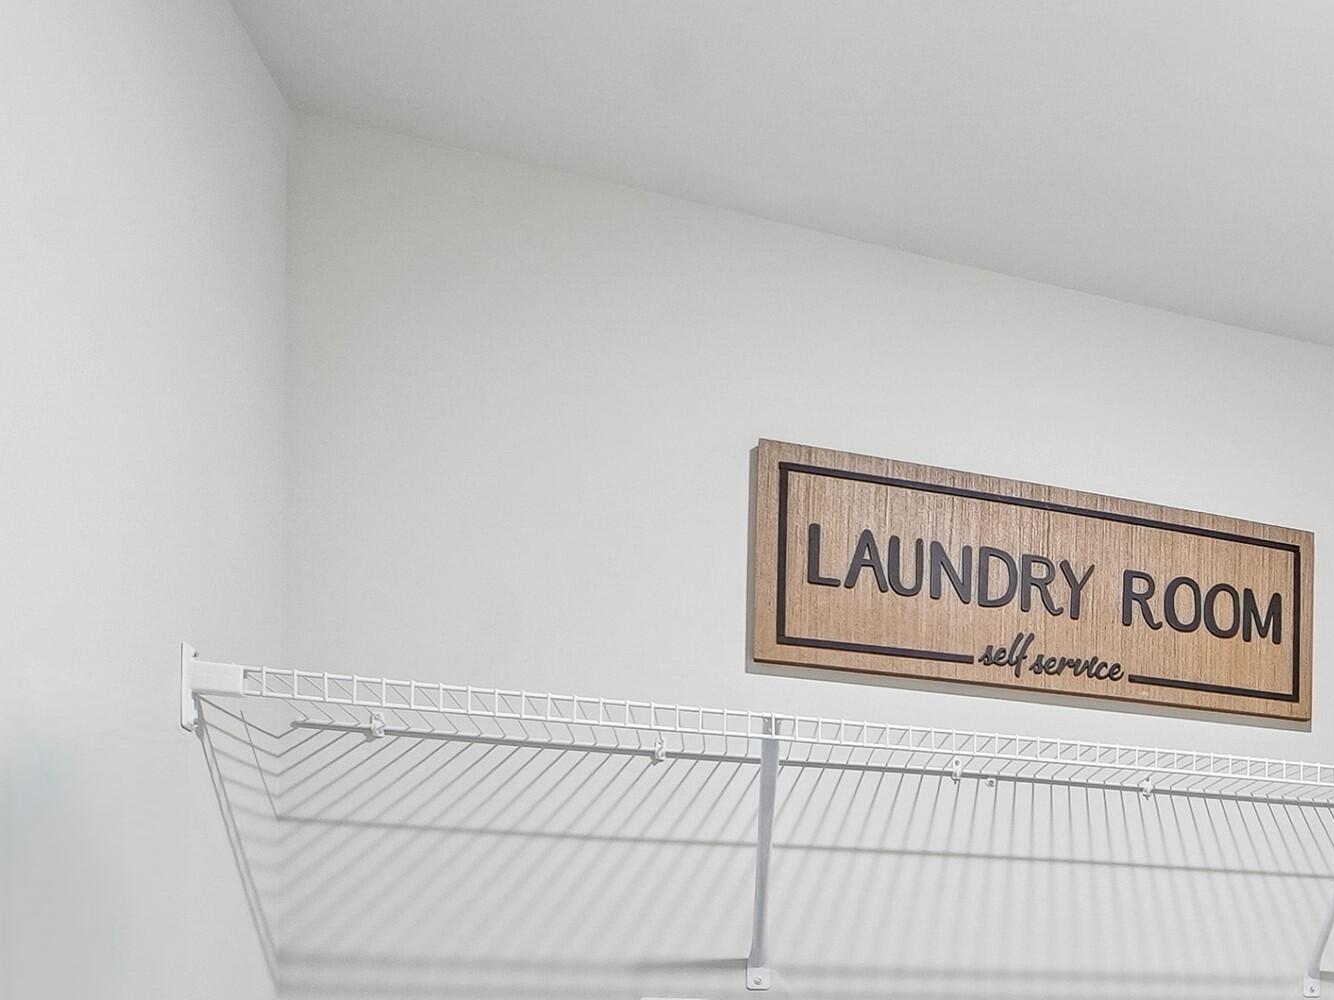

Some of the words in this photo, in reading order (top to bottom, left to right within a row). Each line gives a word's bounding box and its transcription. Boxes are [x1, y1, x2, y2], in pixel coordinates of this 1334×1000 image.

[806, 522, 1095, 621] LAUNDRY
[1121, 569, 1283, 646] ROOM
[978, 632, 1035, 679] self
[1029, 654, 1125, 682] service
